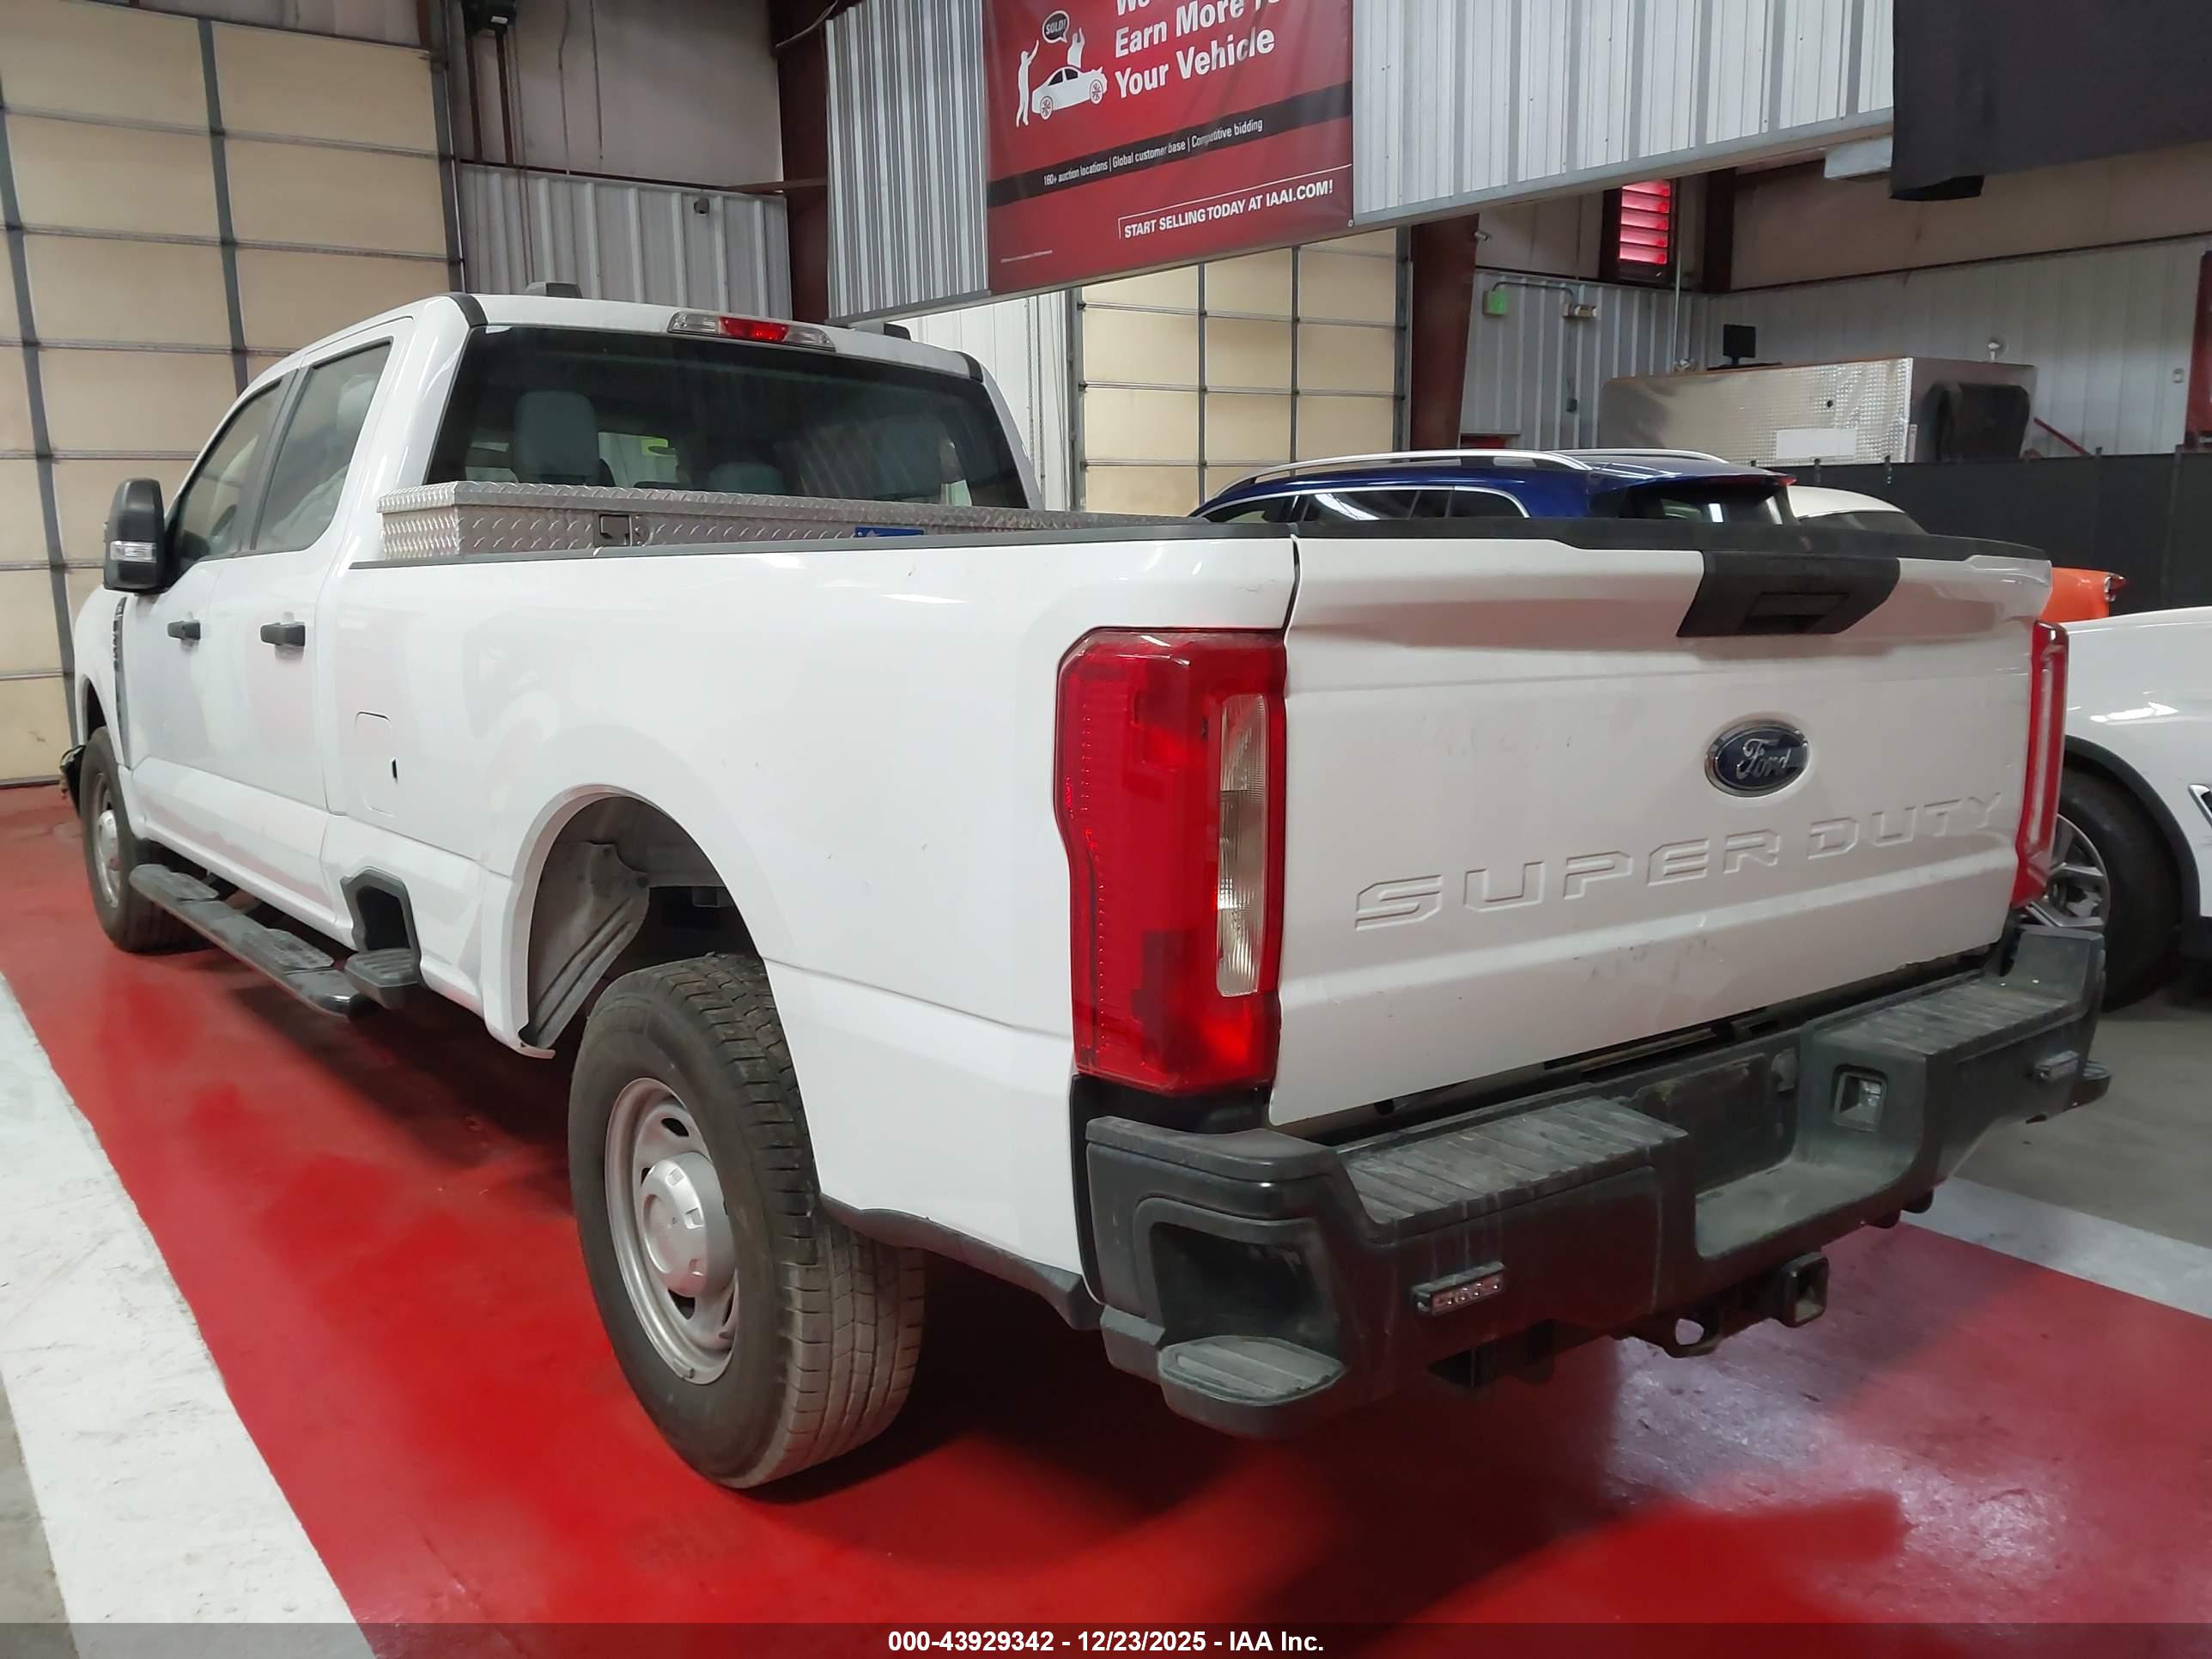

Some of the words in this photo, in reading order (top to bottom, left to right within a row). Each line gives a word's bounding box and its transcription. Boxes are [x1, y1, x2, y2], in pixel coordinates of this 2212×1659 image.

[1045, 19, 1066, 35] SOLD!
[1115, 21, 1167, 58] Earn
[1176, 0, 1244, 37] More
[1115, 64, 1169, 99] Your
[1176, 28, 1275, 80] Vehicle
[1043, 173, 1057, 185] 160+
[1058, 167, 1079, 182] auction
[1080, 161, 1108, 176] locations
[1112, 151, 1133, 167] Global
[1135, 147, 1167, 162] customer
[1168, 141, 1186, 154] base
[1191, 127, 1232, 148] Competitive
[1234, 119, 1263, 136] bidding
[1124, 219, 1157, 239] START
[1158, 209, 1206, 231] SELLING
[1206, 199, 1246, 219] TODAY
[1248, 195, 1264, 211] AT
[1266, 179, 1334, 207] IAAI.COM!
[1735, 738, 1792, 781] Ford
[1354, 828, 1782, 932] SUPER
[1807, 792, 2001, 860] DUTY
